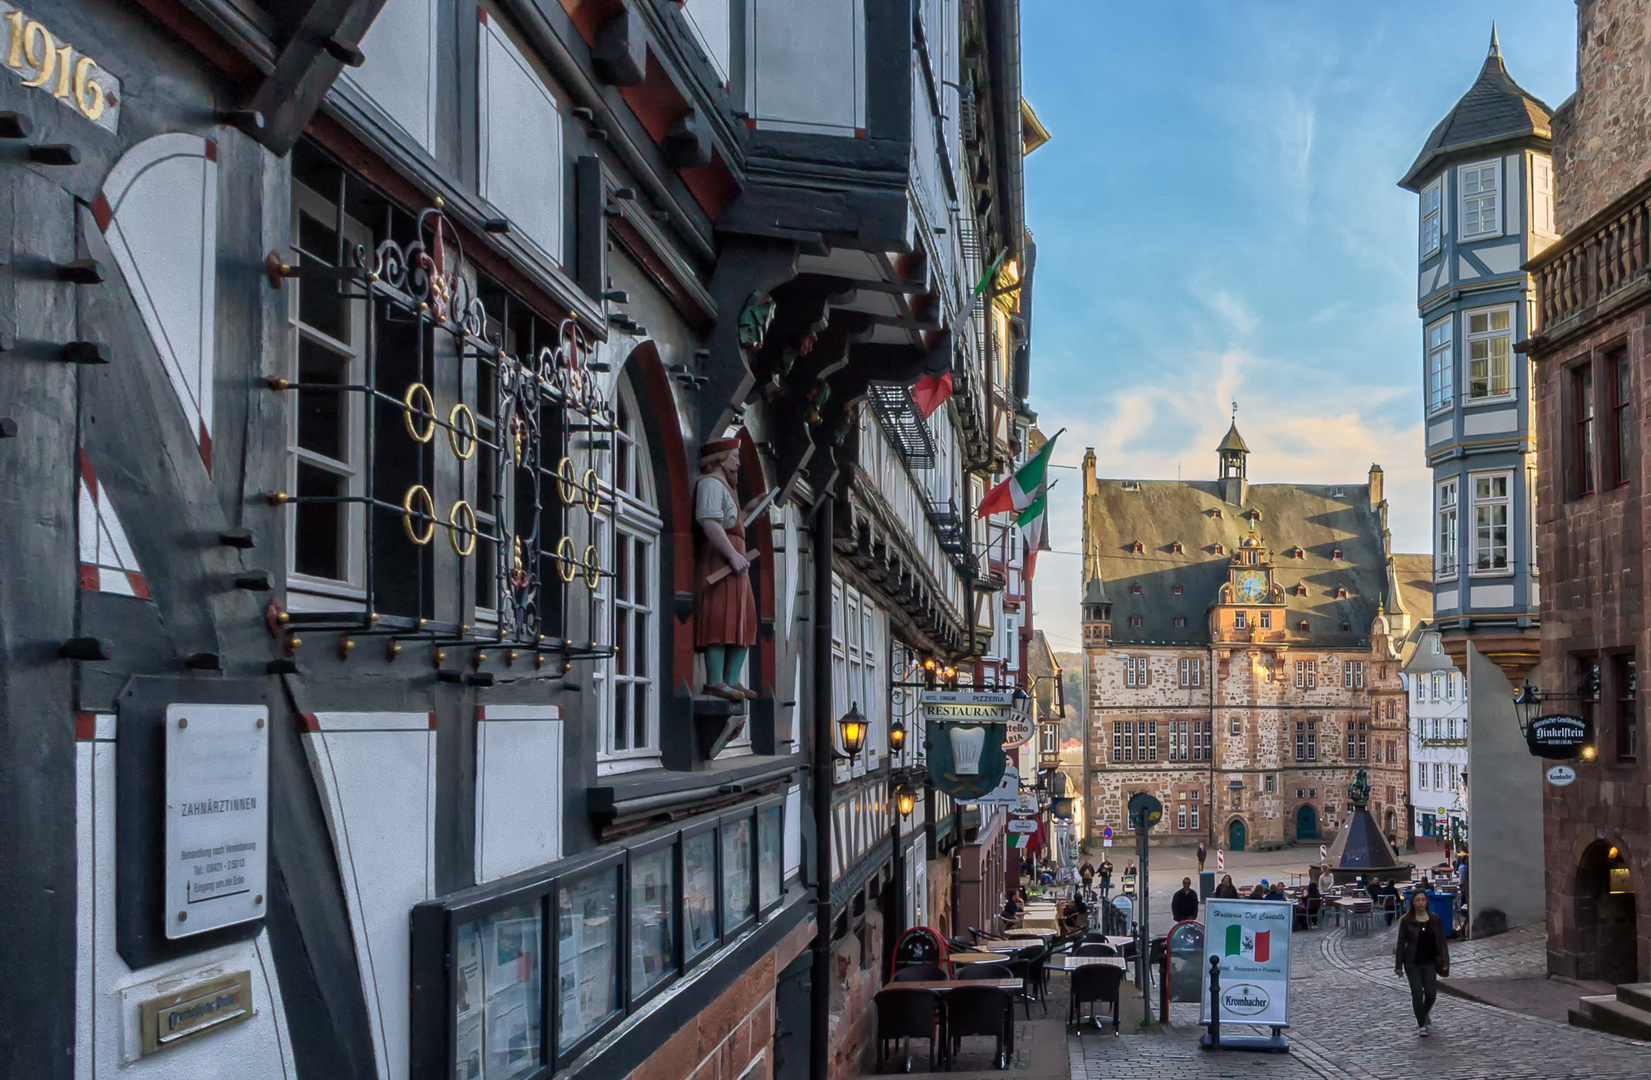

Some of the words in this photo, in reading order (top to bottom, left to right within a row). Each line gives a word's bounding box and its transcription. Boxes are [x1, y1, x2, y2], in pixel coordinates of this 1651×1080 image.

[4, 8, 105, 120] 1916
[927, 706, 1006, 717] RESTAURANT
[181, 797, 257, 817] ZAHNÄRZTINNEN
[1245, 911, 1257, 919] Del
[1259, 912, 1285, 920] Castello
[1225, 996, 1267, 1007] Krombacher
